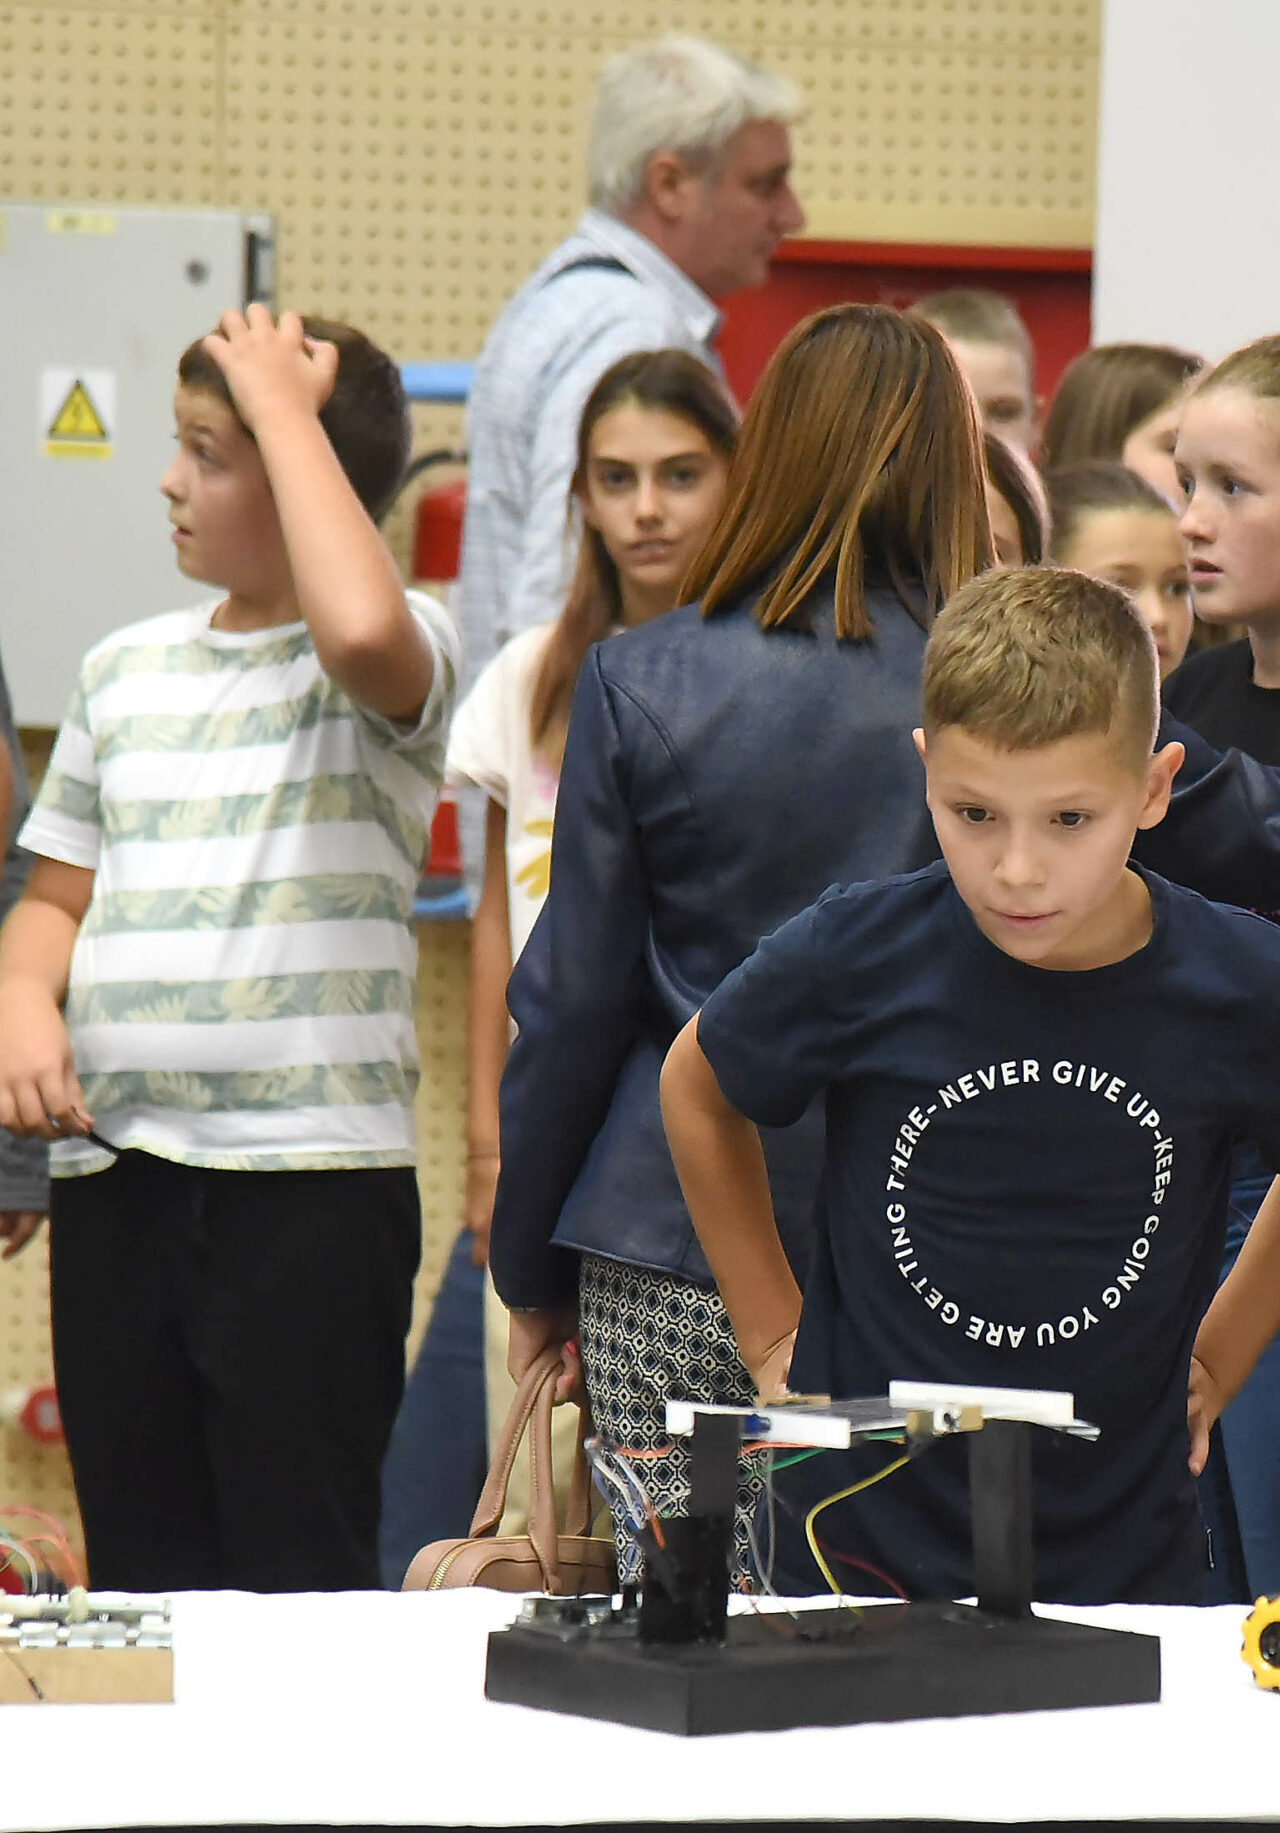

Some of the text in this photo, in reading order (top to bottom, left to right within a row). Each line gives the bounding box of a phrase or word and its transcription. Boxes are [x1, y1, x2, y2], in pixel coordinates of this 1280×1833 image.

[1052, 1060, 1127, 1103] GIVE
[886, 1203, 960, 1325] GETTING
[1101, 1214, 1160, 1309] GOING
[965, 1315, 1026, 1349] ARE
[1036, 1306, 1100, 1347] YOU
